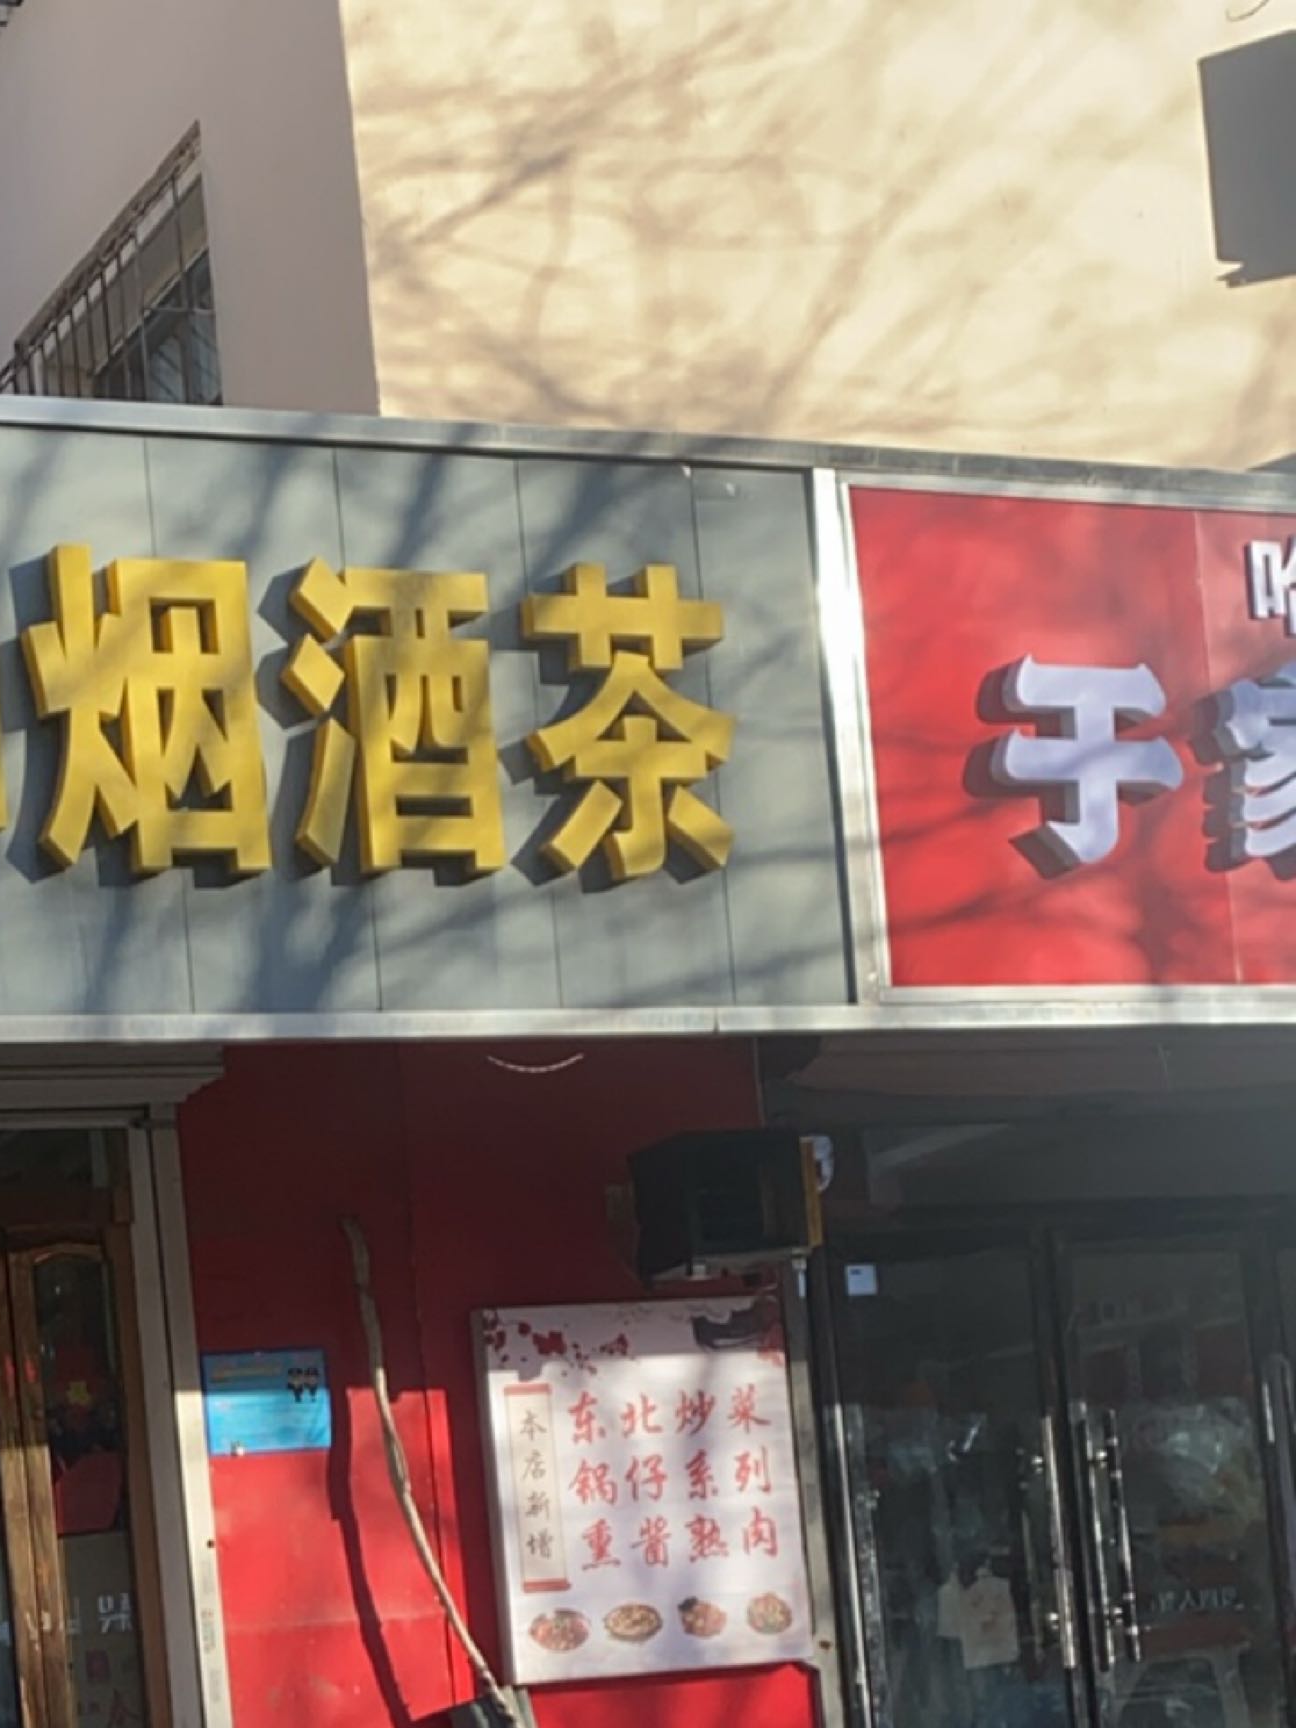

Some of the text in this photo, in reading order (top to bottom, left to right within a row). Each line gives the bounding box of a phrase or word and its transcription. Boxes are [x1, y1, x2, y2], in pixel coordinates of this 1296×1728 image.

[568, 1383, 771, 1444] 东北炒菜
[519, 1409, 554, 1560] 本店新增
[568, 1446, 772, 1505] 锅仔系列
